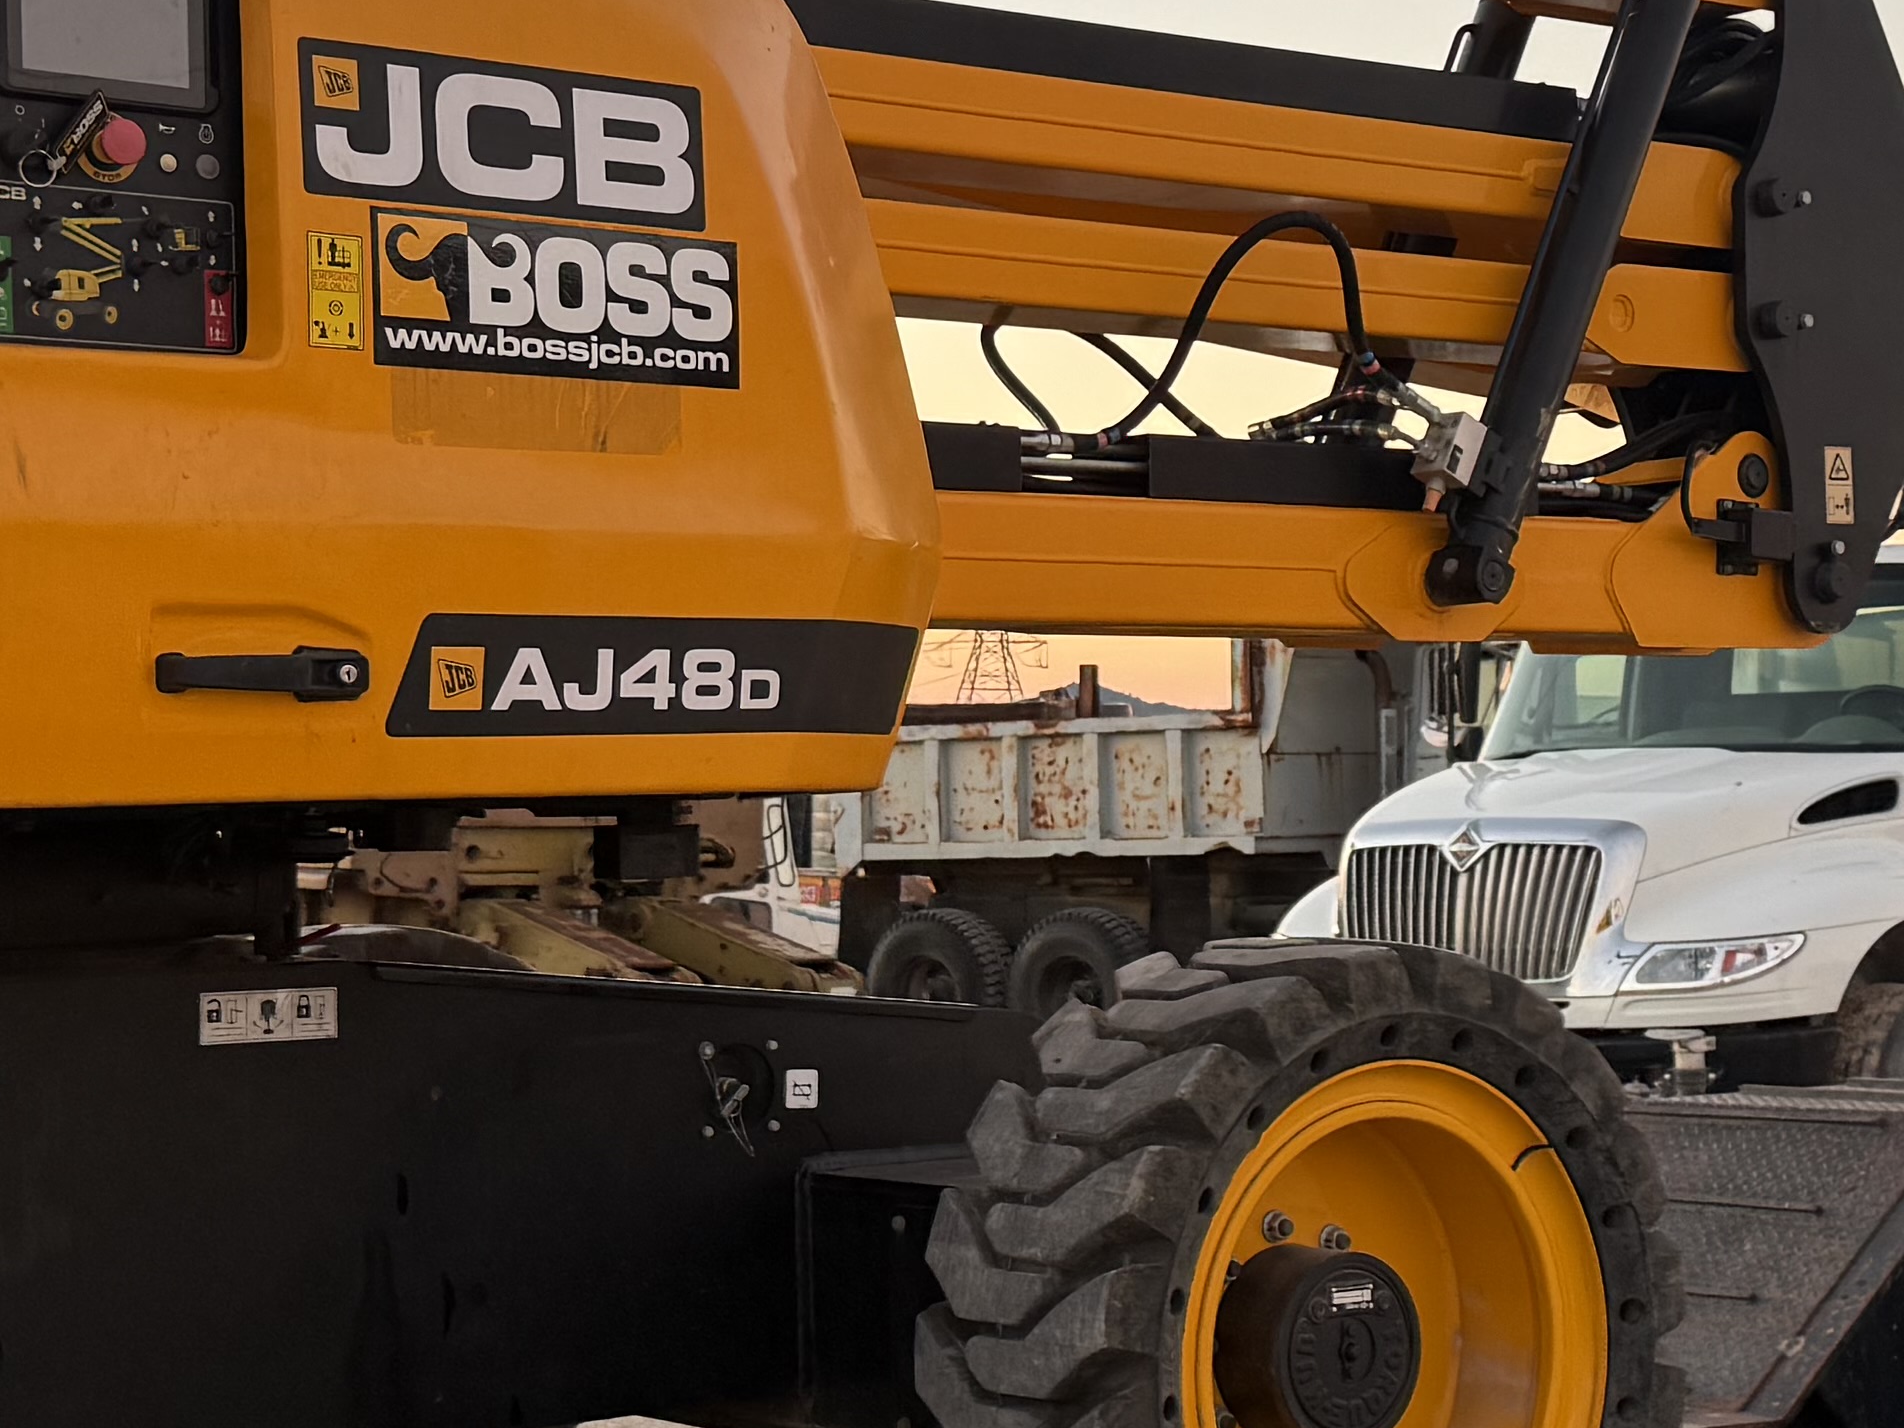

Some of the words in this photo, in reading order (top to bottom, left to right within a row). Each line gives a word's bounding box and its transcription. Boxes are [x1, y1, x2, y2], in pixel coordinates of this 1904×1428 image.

[315, 63, 696, 215] JCB
[467, 233, 733, 343] BOSS
[384, 327, 731, 373] www.bossjcb.com
[443, 662, 476, 694] JCB
[490, 647, 782, 712] AJ48D
